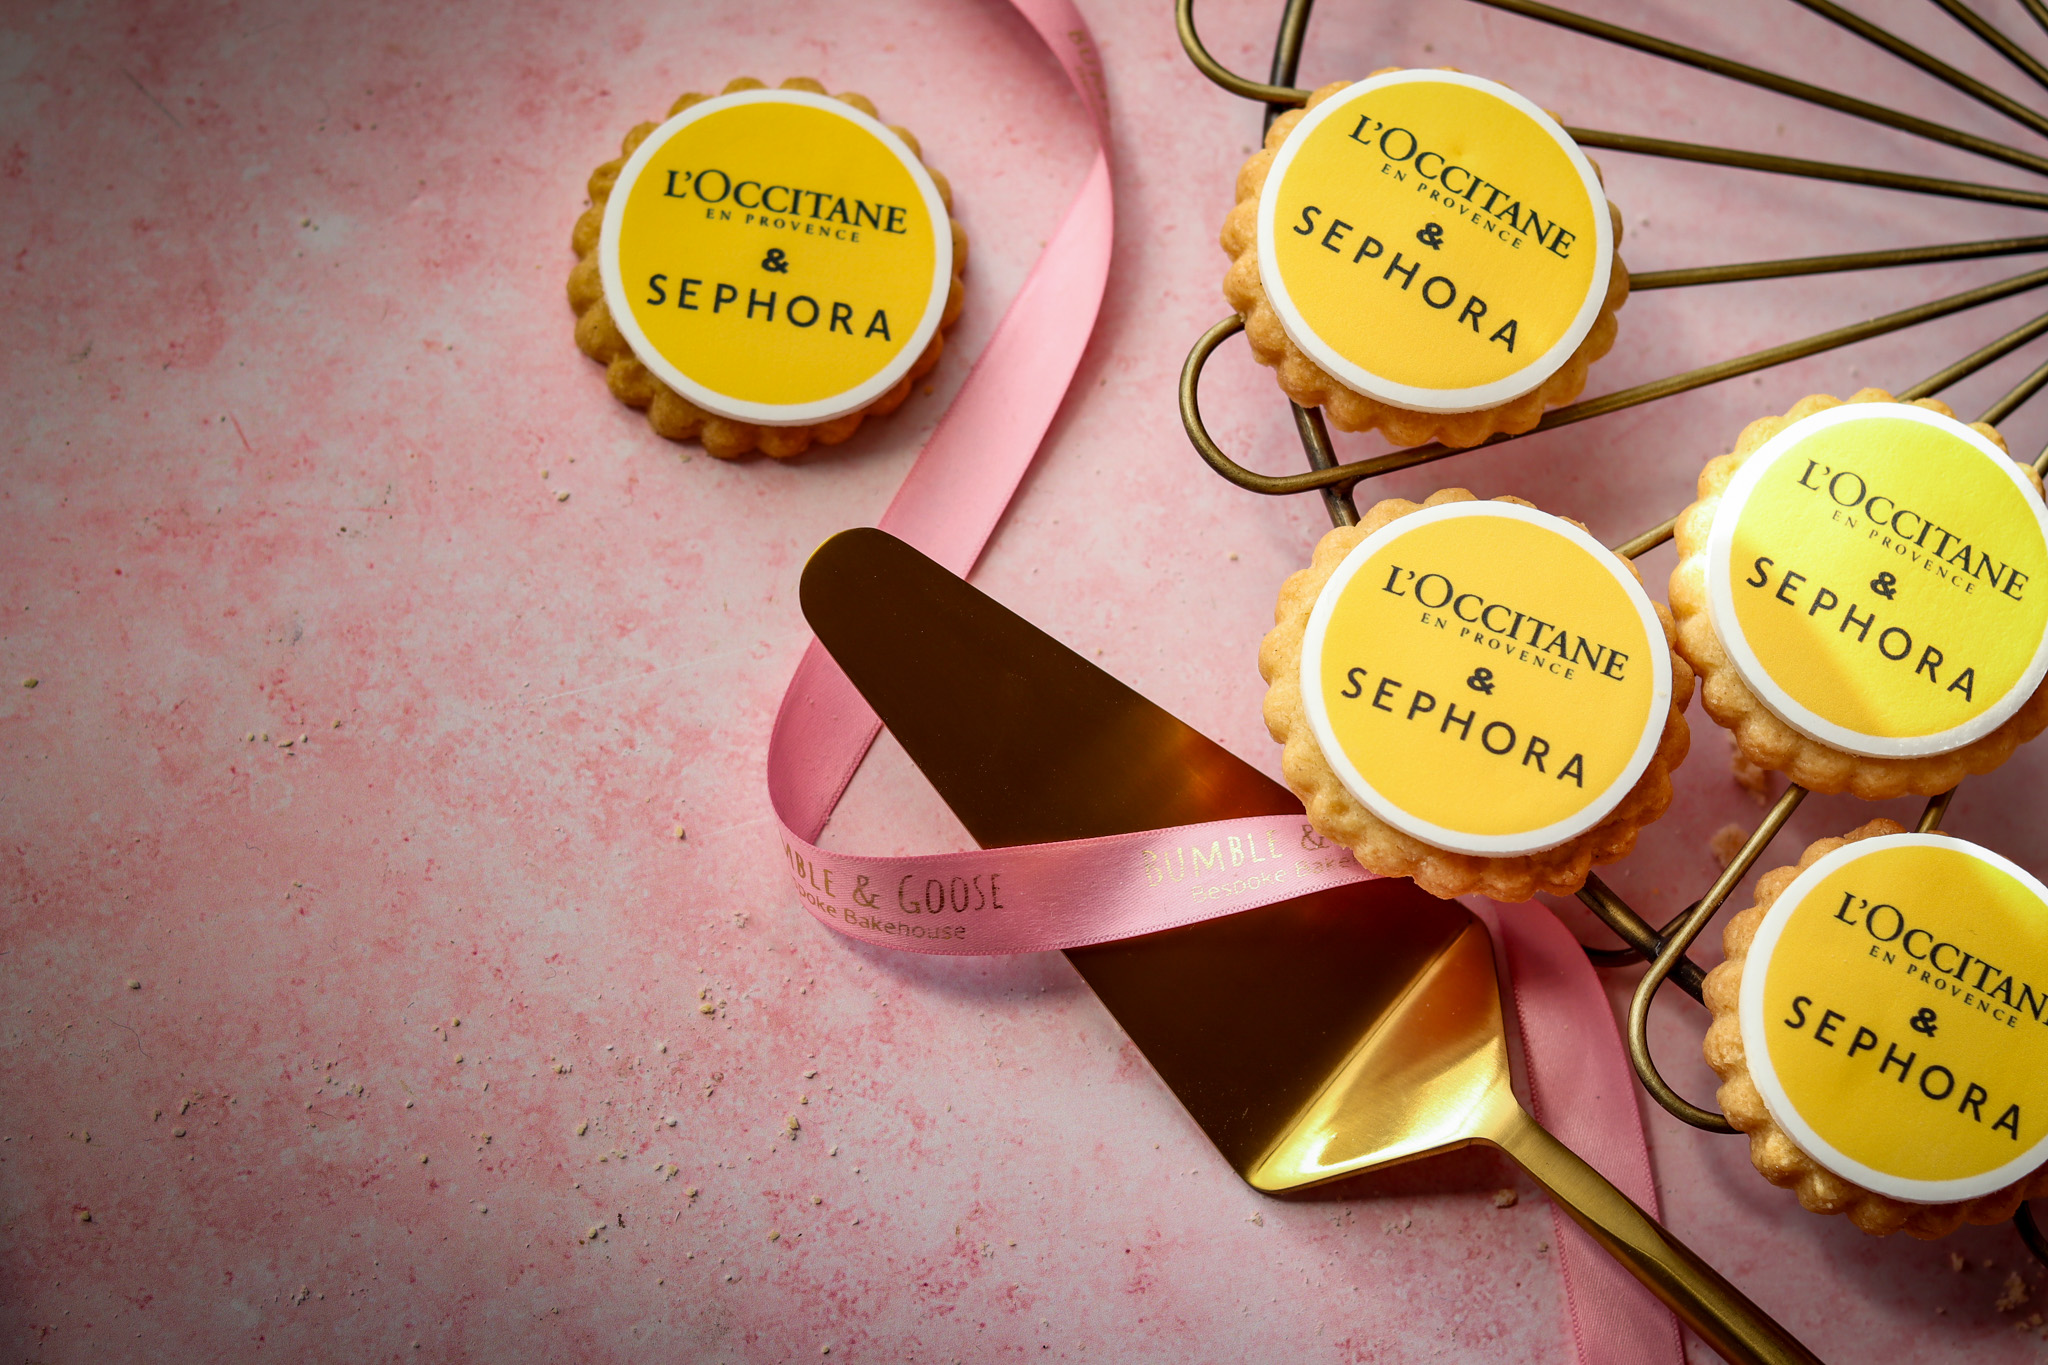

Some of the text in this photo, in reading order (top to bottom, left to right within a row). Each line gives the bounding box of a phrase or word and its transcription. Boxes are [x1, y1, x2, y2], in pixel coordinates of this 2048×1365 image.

[664, 169, 907, 234] L'OCCITANE
[1348, 115, 1576, 259] L'OCCITANE
[1381, 163, 1522, 249] EN PROVENCE
[706, 207, 860, 243] EN PROVENCE
[1416, 222, 1444, 250] &
[761, 248, 789, 274] &
[1293, 206, 1519, 353] SEPHORA
[646, 274, 892, 342] SEPHORA
[1797, 458, 2029, 601] L'OCCITANE
[1833, 510, 1975, 595] EN PROVENCE
[1870, 571, 1897, 600] &
[1382, 565, 1629, 681] L'OCCITANE
[1421, 613, 1575, 680] EN PROVENCE
[1746, 556, 1976, 703] SEPHORA
[1467, 667, 1496, 696] &
[1341, 667, 1585, 788] SEPHORA
[1142, 824, 1330, 887] BUMBLE &
[843, 908, 966, 940] Bakehouse
[852, 874, 880, 910] &
[898, 873, 1003, 915] GOOSE
[1833, 891, 2048, 1026] L'OCCITAN
[1869, 945, 2018, 1029] EN PROVENCE
[1909, 1007, 1939, 1038] &
[1784, 995, 2021, 1141] SEPHORA
